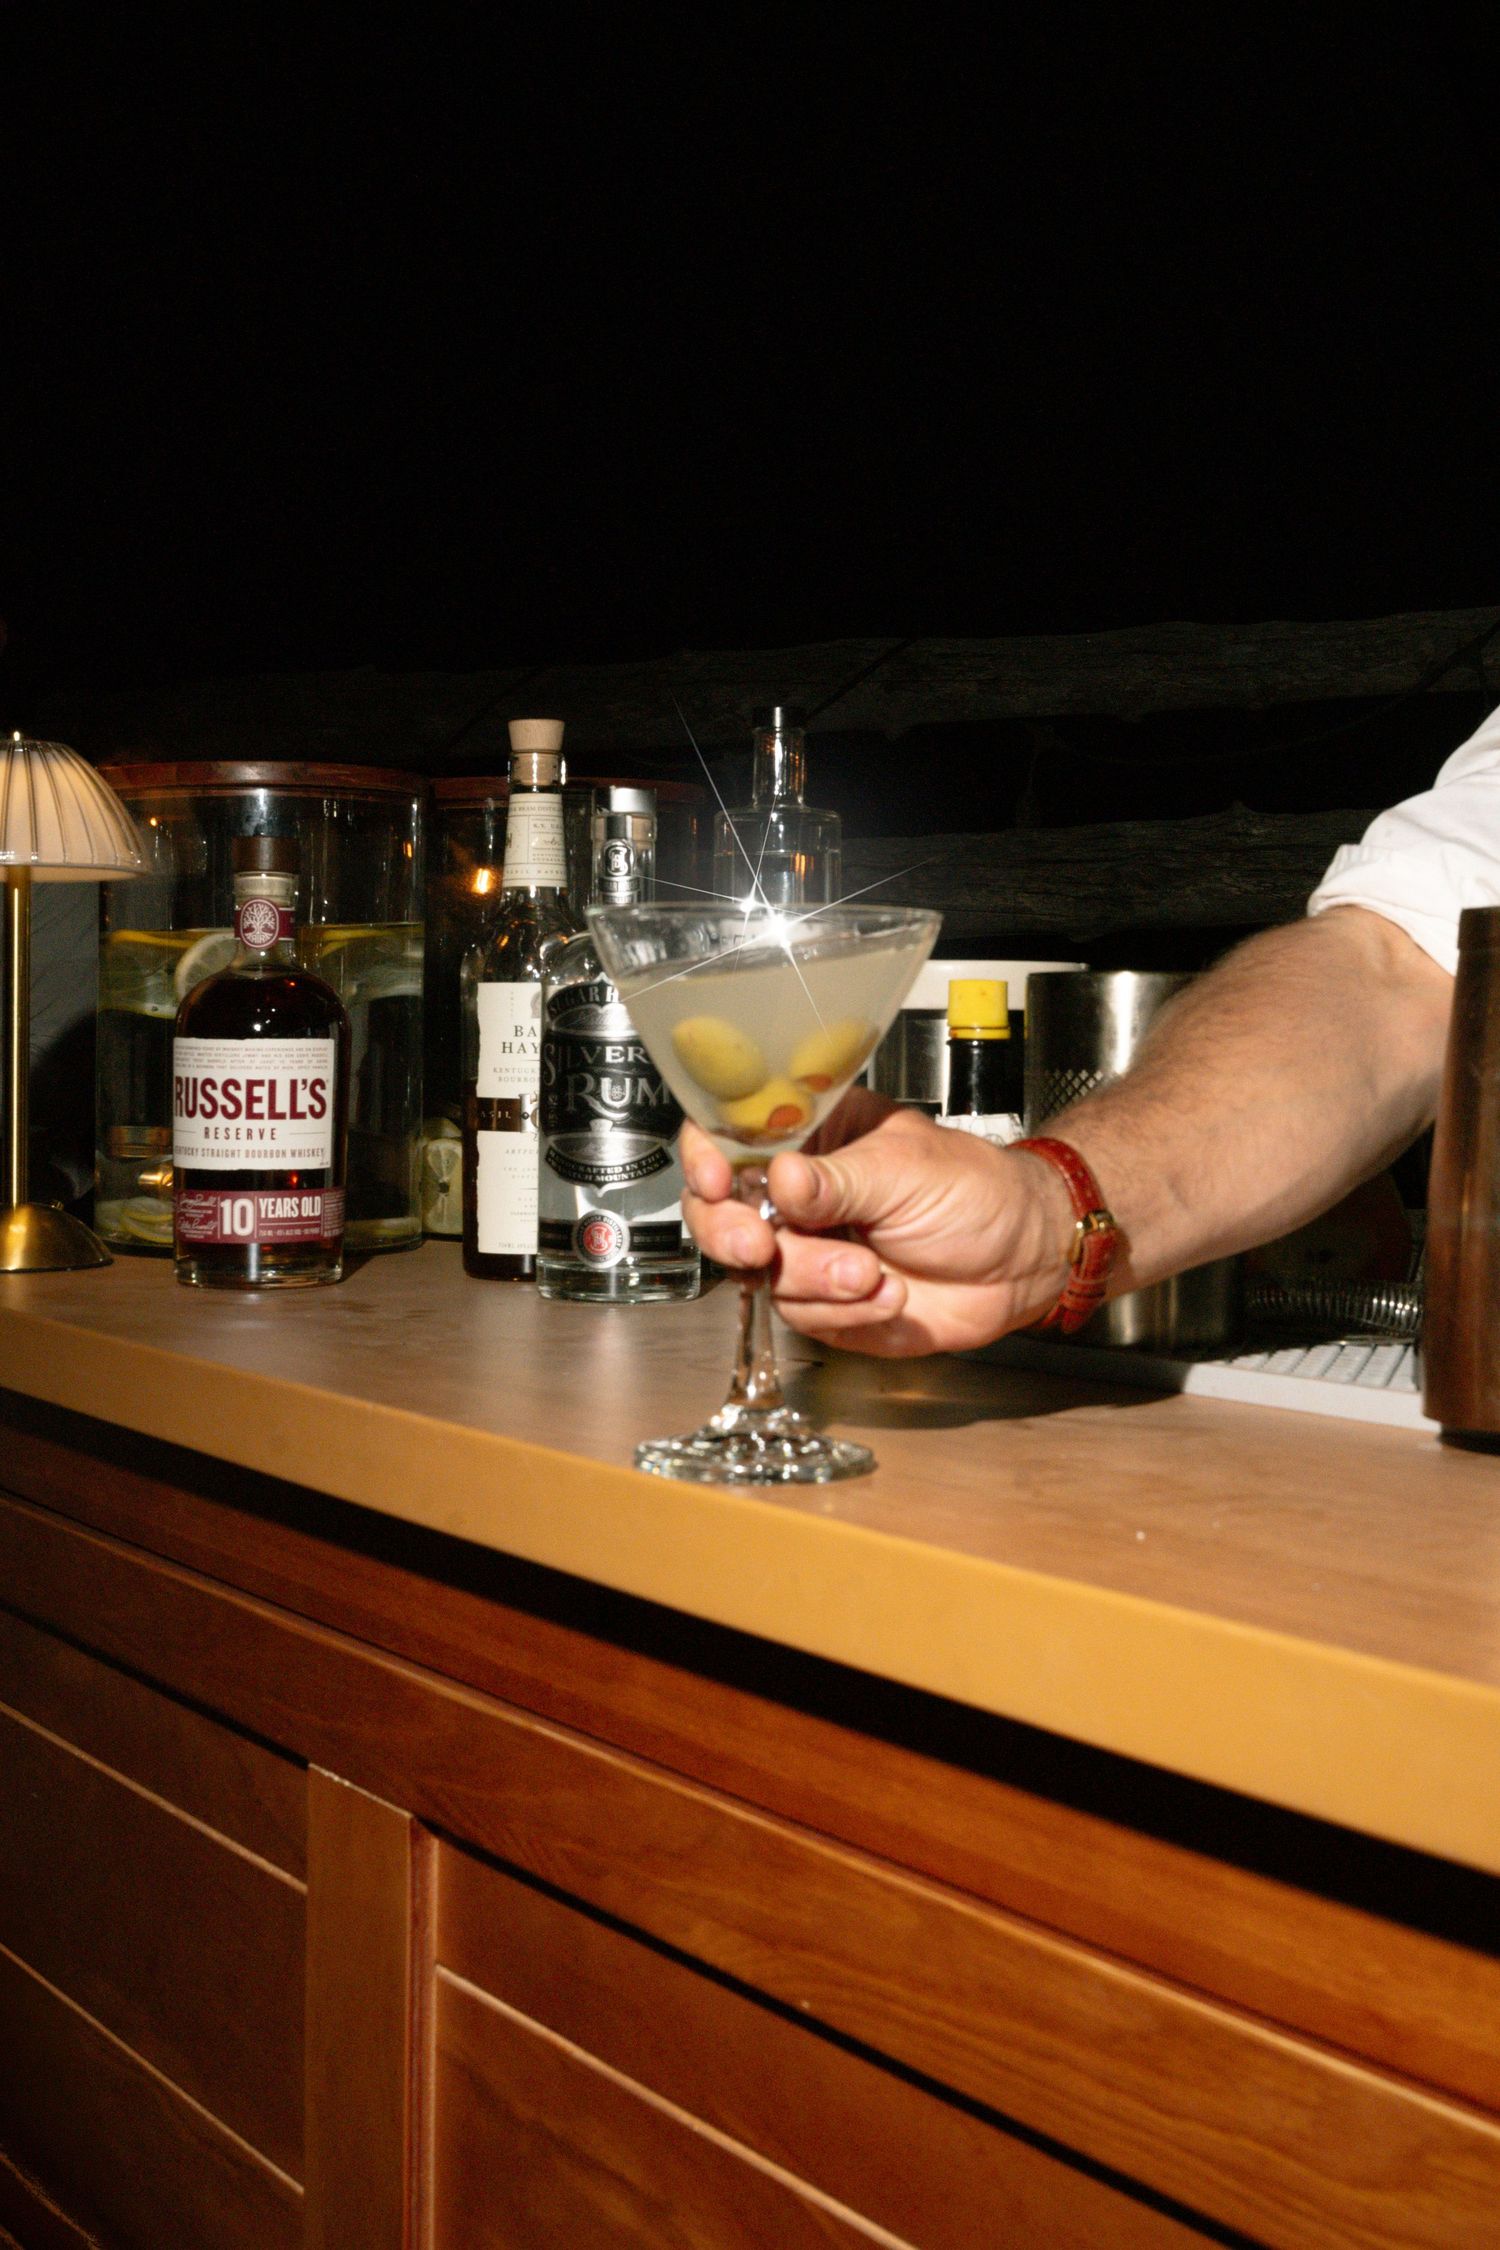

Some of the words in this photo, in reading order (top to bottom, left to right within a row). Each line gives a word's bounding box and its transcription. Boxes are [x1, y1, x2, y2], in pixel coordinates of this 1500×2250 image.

[514, 1025, 538, 1038] BA
[501, 1041, 540, 1055] HAY
[543, 1042, 650, 1087] SILVER
[498, 1075, 536, 1083] BOURBO
[175, 1076, 327, 1120] RUSSELL'S
[564, 1072, 671, 1120] RUM
[204, 1126, 277, 1141] RESERVE
[201, 1147, 241, 1159] STRAIGHT
[245, 1148, 288, 1159] BOURBON
[290, 1147, 325, 1159] WHISKEY
[220, 1198, 255, 1237] 10
[258, 1197, 300, 1219] YEARS
[301, 1196, 322, 1217] OLD
